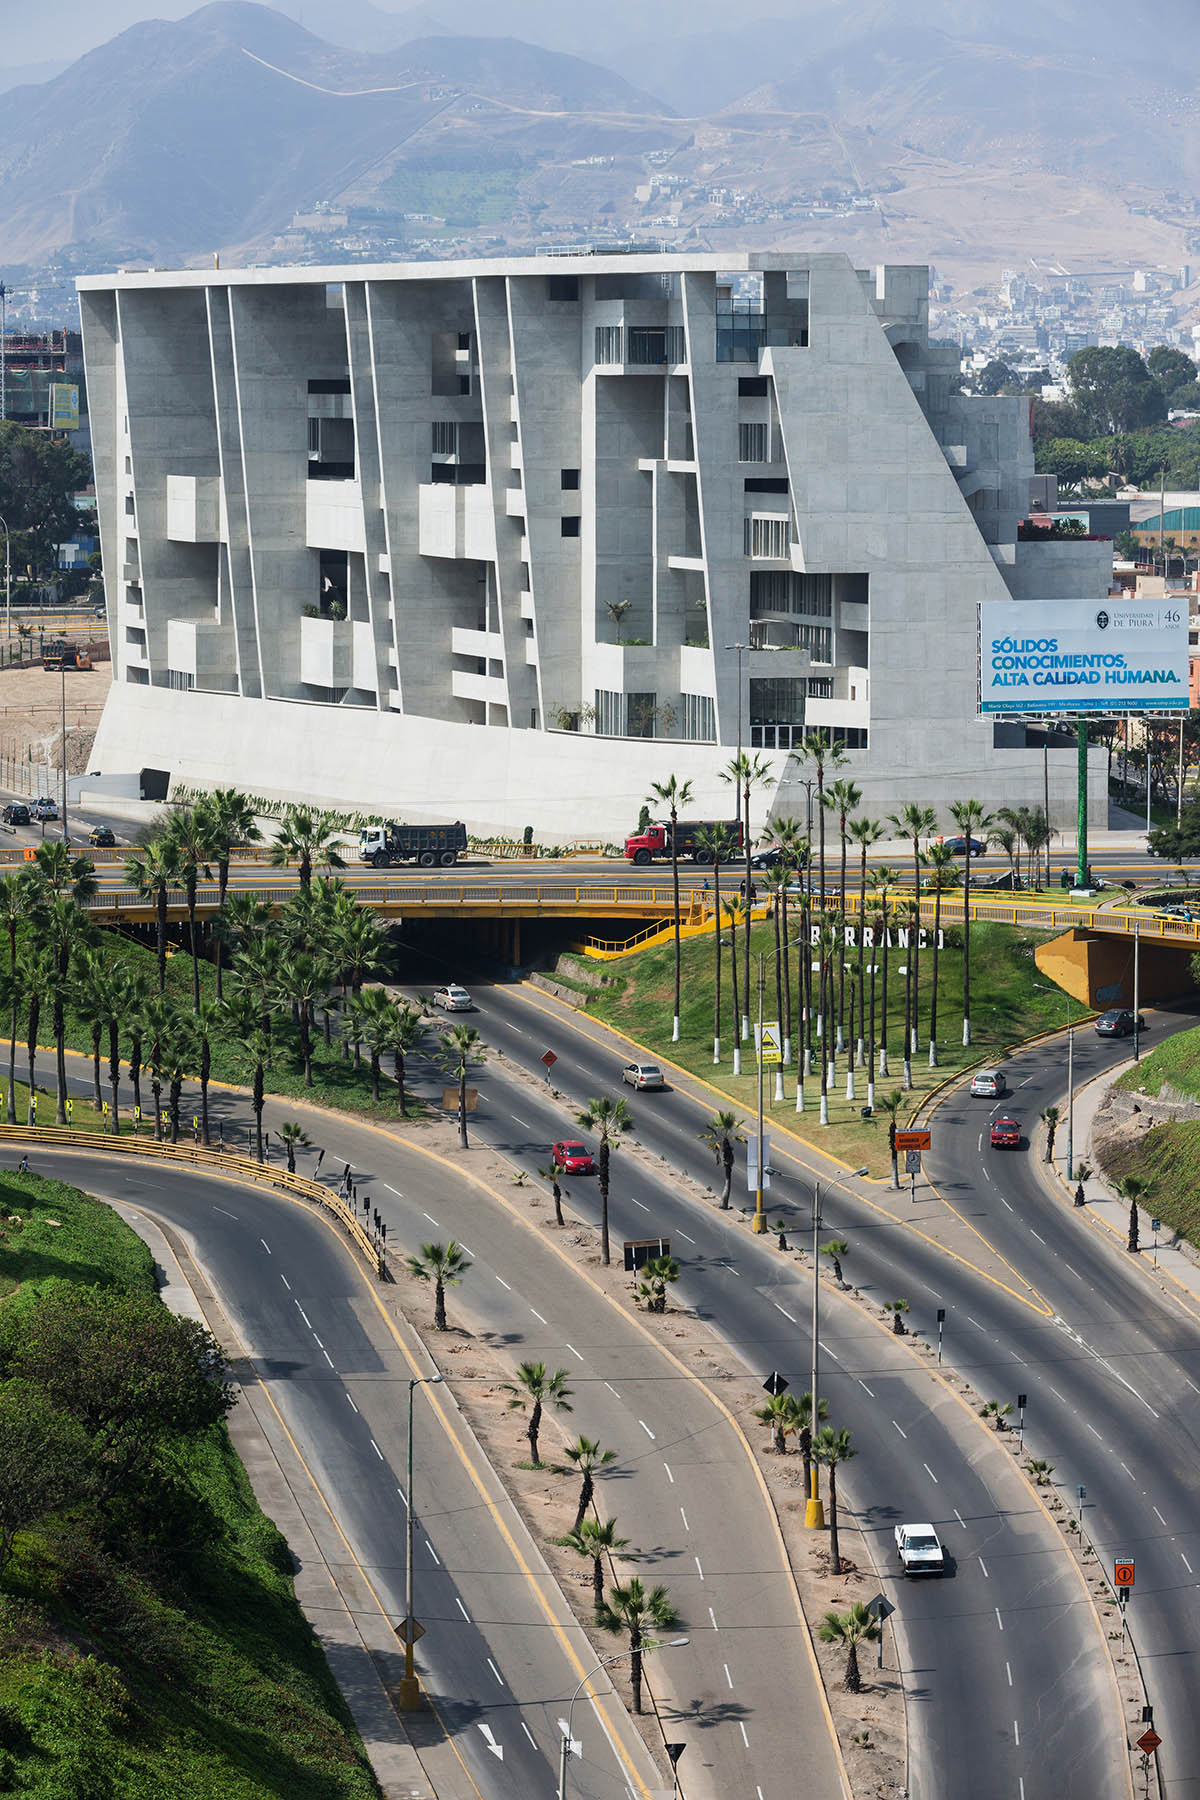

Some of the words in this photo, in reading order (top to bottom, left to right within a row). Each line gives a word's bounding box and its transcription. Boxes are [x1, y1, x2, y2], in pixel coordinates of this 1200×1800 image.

[1129, 619, 1154, 627] PIURA
[1164, 610, 1180, 622] 46
[992, 636, 1058, 653] SÓLIDOS
[992, 654, 1127, 670] CONOCIMIENTOS,
[992, 672, 1029, 687] ALTA
[1033, 671, 1101, 686] CALIDAD
[1105, 670, 1181, 684] HUMANA.
[811, 925, 944, 949] BRRANCO
